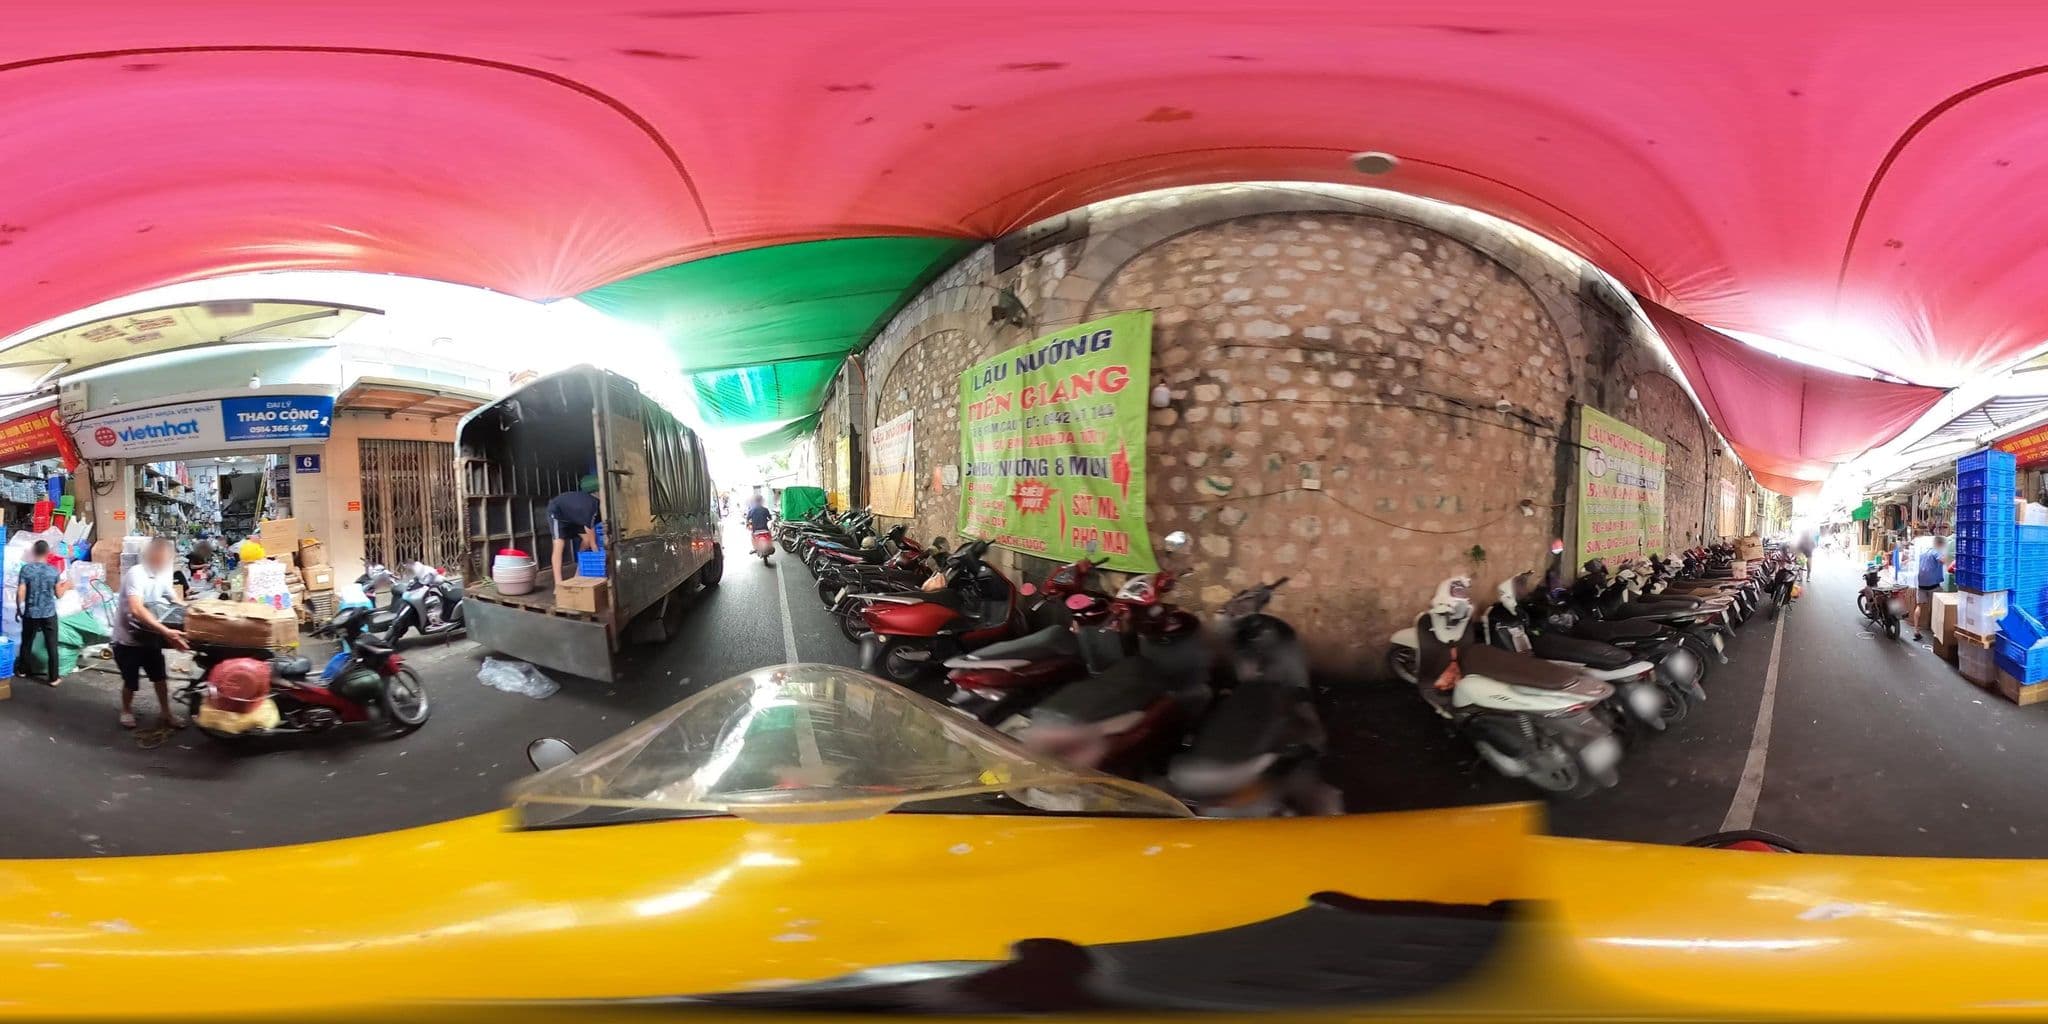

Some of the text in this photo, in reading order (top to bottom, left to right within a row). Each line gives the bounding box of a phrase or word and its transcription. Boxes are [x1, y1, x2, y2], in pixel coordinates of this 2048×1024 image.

[1020, 365, 1129, 410] GIANG
[237, 408, 319, 422] THAO CỘNG
[118, 419, 199, 441] vietnhat
[303, 456, 312, 467] 6
[1055, 458, 1064, 476] 8
